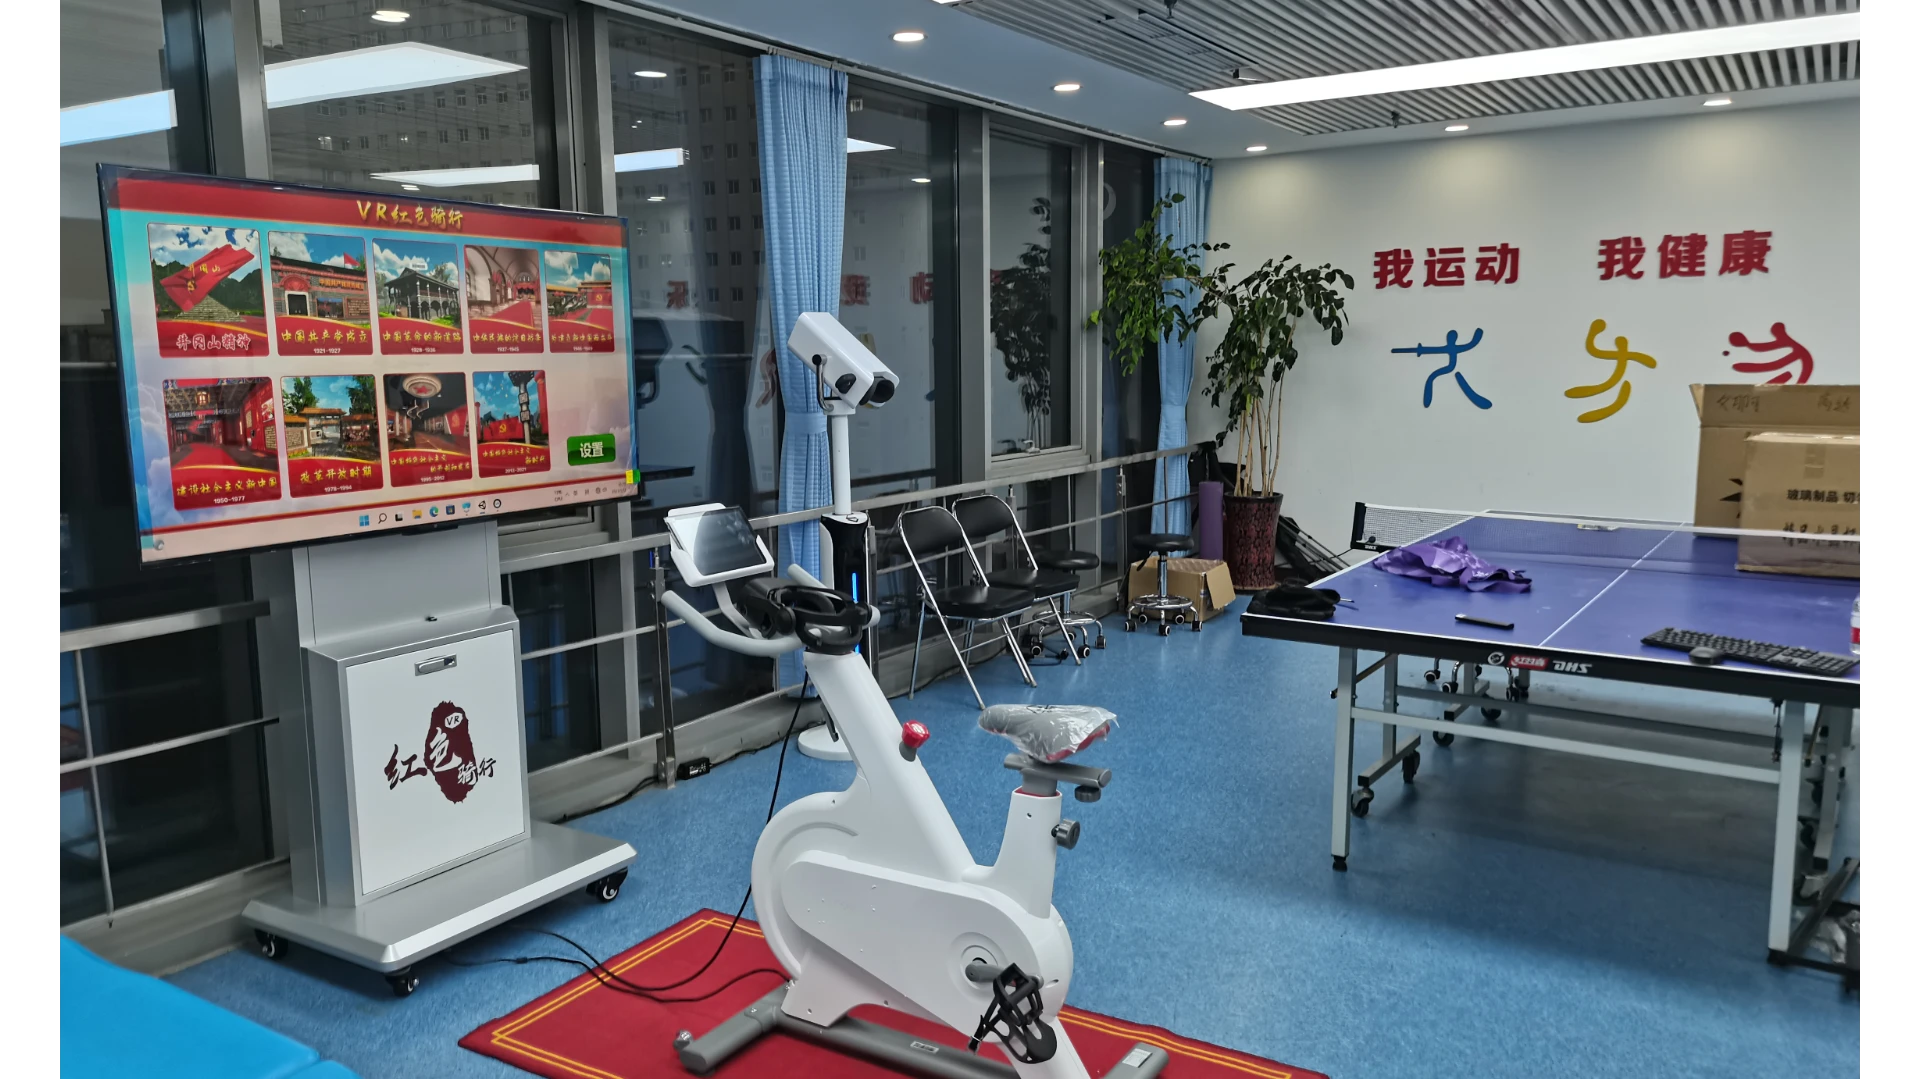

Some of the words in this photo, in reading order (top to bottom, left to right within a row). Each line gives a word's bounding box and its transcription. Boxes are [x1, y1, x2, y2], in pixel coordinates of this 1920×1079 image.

[1373, 242, 1520, 290] 我运动
[1598, 229, 1772, 281] 我健康
[176, 333, 252, 351] 井冈山精神
[281, 328, 368, 344] 中国共产党成立
[382, 330, 461, 343] 中国革命的新道路
[580, 442, 605, 458] 设置
[300, 466, 372, 485] 改革开放时期
[176, 477, 278, 497] 建设社会主义新中国
[1787, 489, 1838, 503] 玻璃制品
[1552, 660, 1593, 674] DHS
[446, 715, 460, 726] VR
[384, 727, 497, 790] 红色骑行
